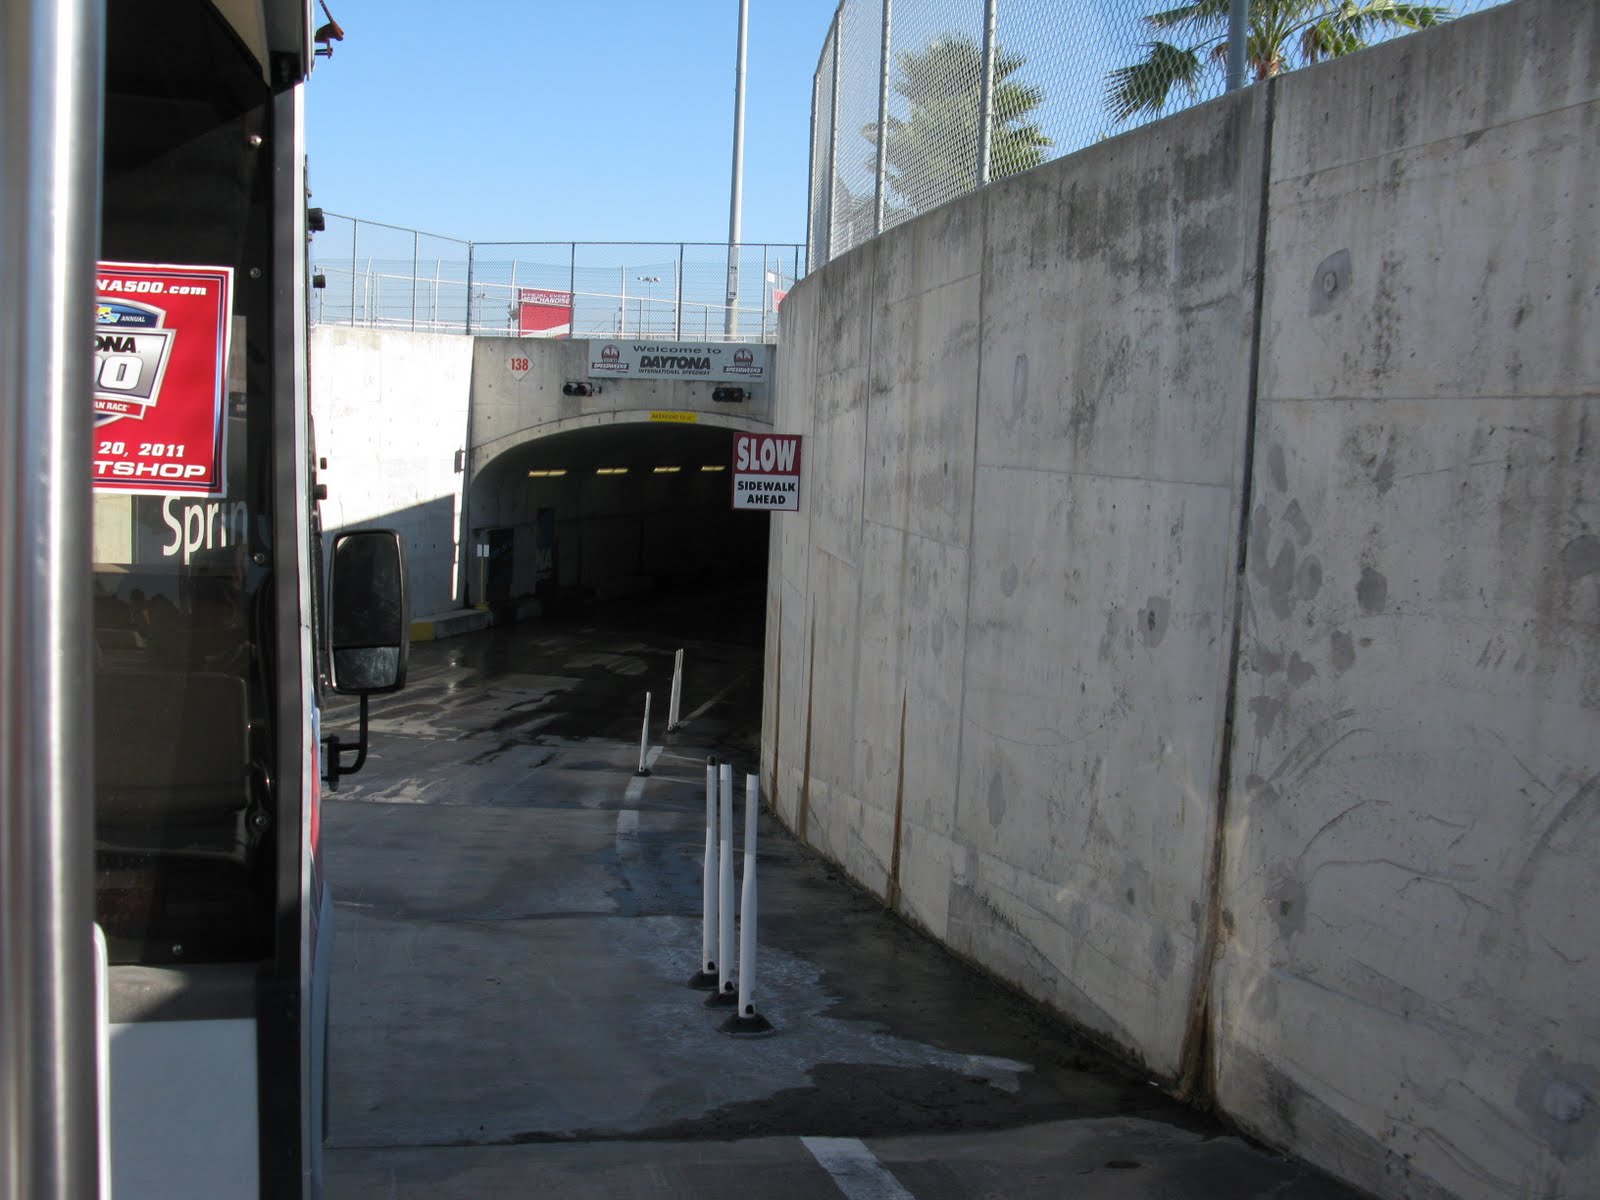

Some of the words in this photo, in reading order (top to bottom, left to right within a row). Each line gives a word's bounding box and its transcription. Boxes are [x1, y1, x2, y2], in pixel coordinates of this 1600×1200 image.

[120, 315, 146, 323] ANNUAL
[633, 345, 706, 354] Welcome
[707, 347, 722, 355] to
[511, 358, 529, 371] 138
[639, 355, 711, 369] DAYTONA
[106, 402, 128, 411] RACE
[98, 441, 129, 457] 20,
[138, 443, 185, 457] 2011
[736, 437, 797, 472] SLOW
[93, 460, 206, 478] TSHOP
[737, 480, 796, 492] SIDEWALK
[747, 493, 786, 505] AHEAD
